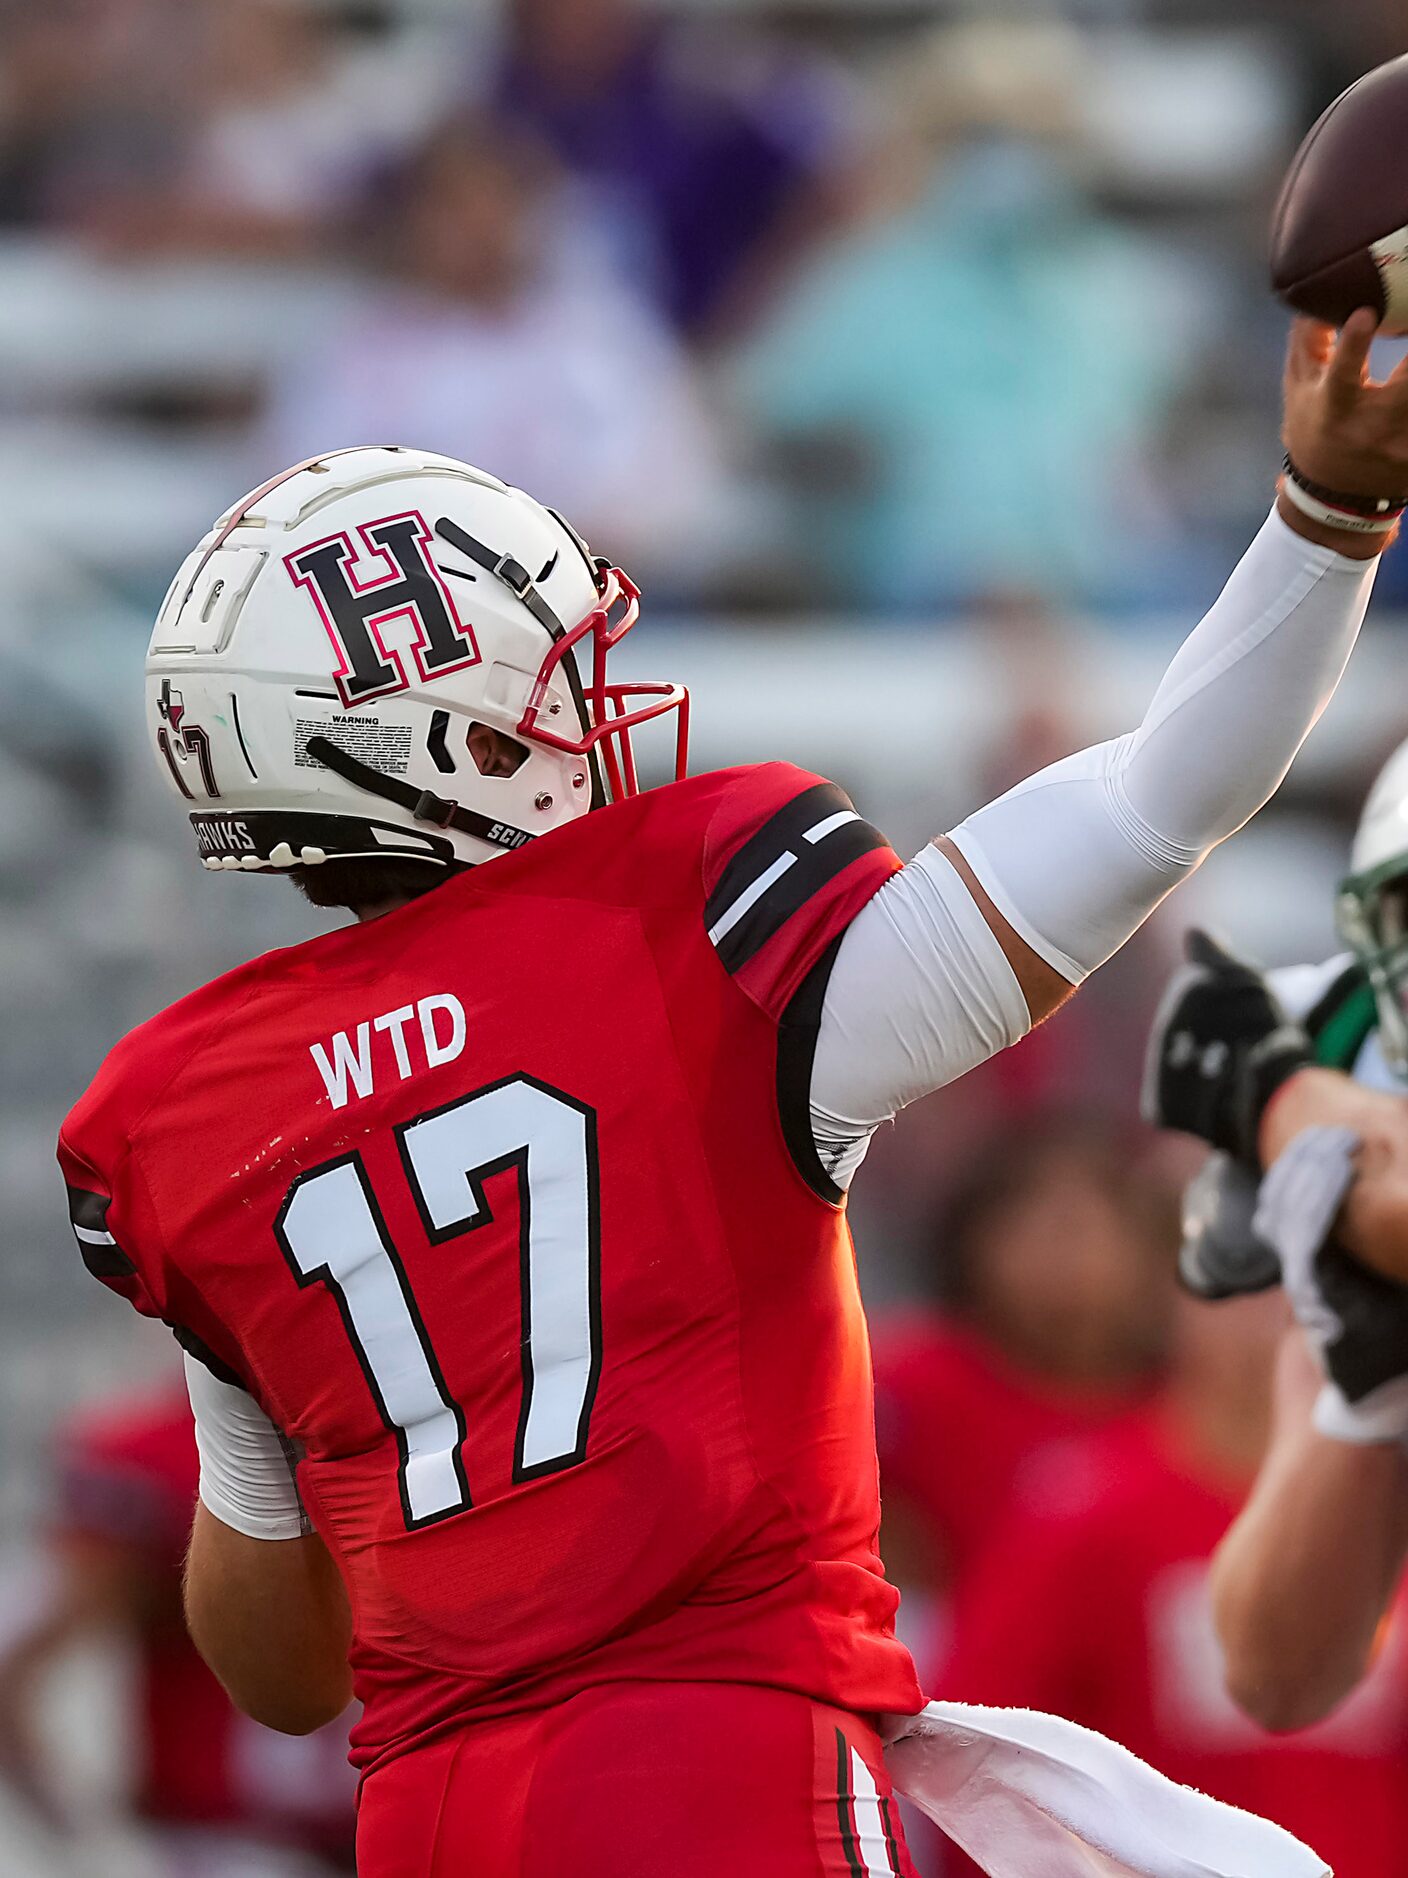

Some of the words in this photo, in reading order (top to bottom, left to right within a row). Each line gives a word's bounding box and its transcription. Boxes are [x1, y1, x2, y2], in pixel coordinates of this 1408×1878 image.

[281, 510, 482, 709] H
[157, 725, 221, 800] 17
[332, 714, 380, 725] WARNING
[310, 993, 467, 1110] WTD
[272, 1071, 603, 1532] 17
